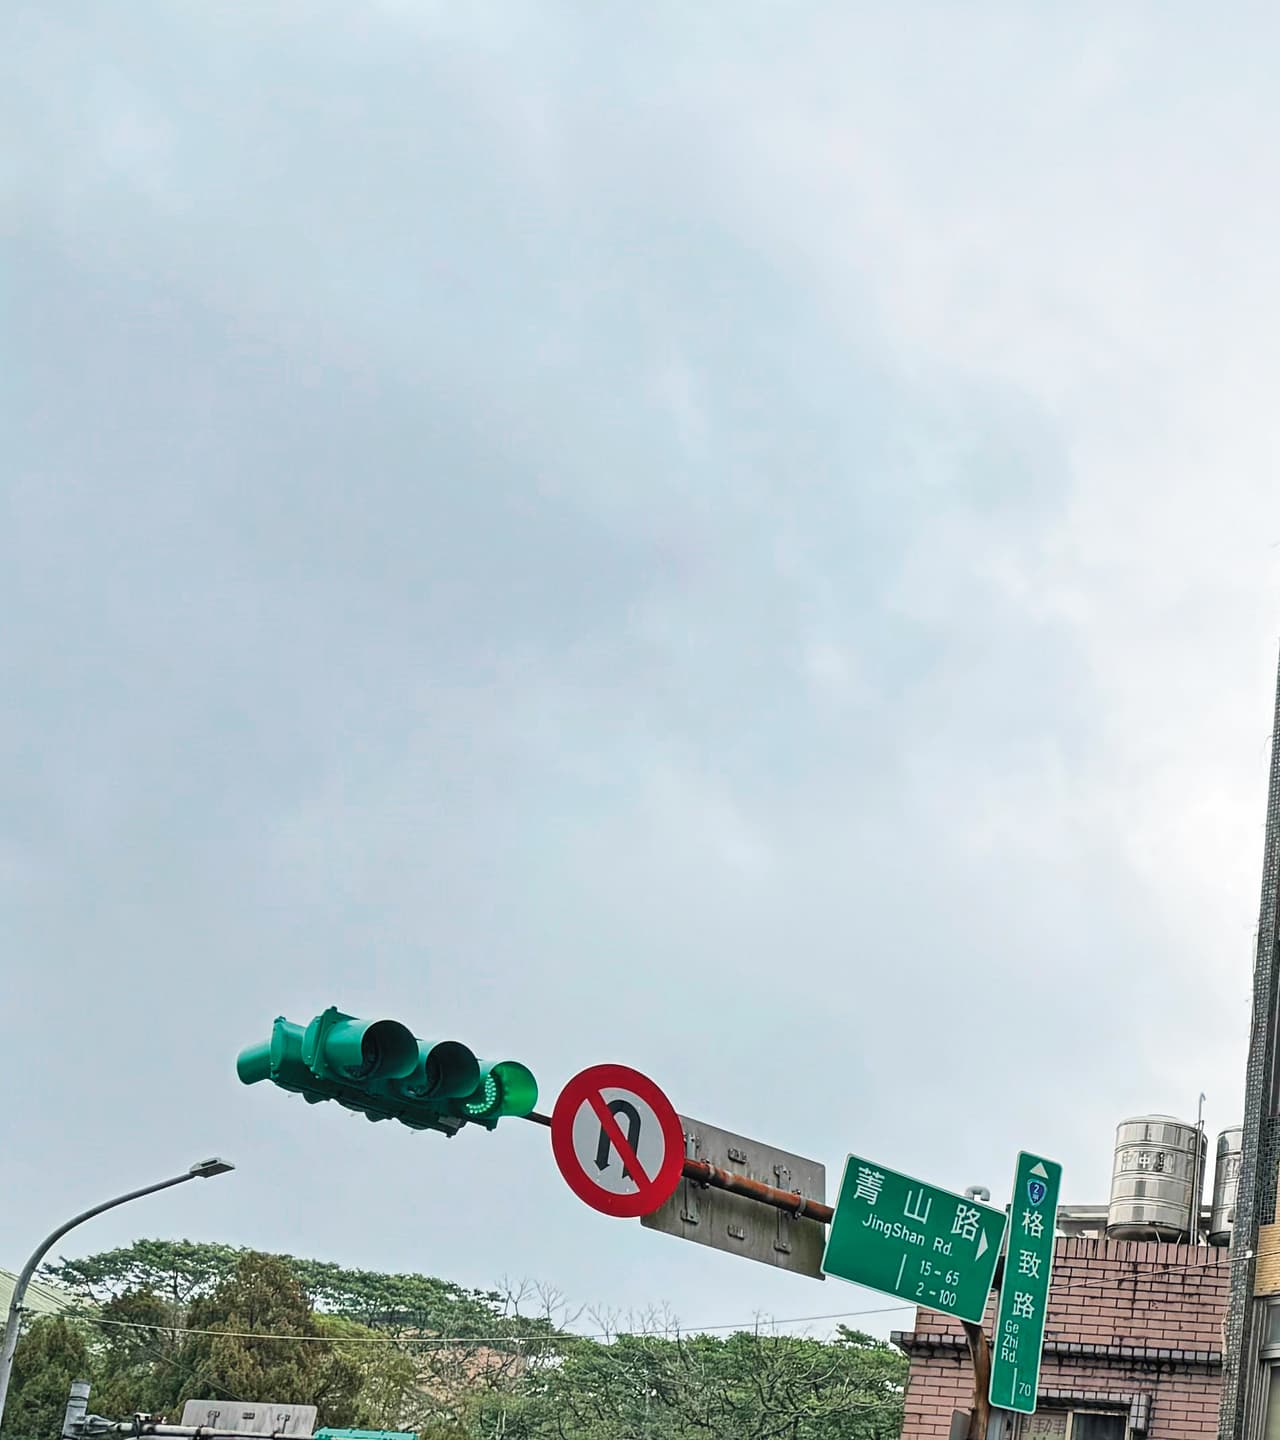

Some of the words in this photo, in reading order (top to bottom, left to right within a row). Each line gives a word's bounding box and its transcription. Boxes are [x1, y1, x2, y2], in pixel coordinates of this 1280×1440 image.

[853, 1166, 982, 1243] 菁山路
[862, 1213, 926, 1247] JingShan
[932, 1236, 953, 1258] Rd.
[1011, 1207, 1045, 1321] 格致路
[1005, 1319, 1020, 1335] Ge
[1002, 1333, 1020, 1349] Zhi
[1001, 1347, 1019, 1364] Rd.
[1018, 1381, 1032, 1398] 70
